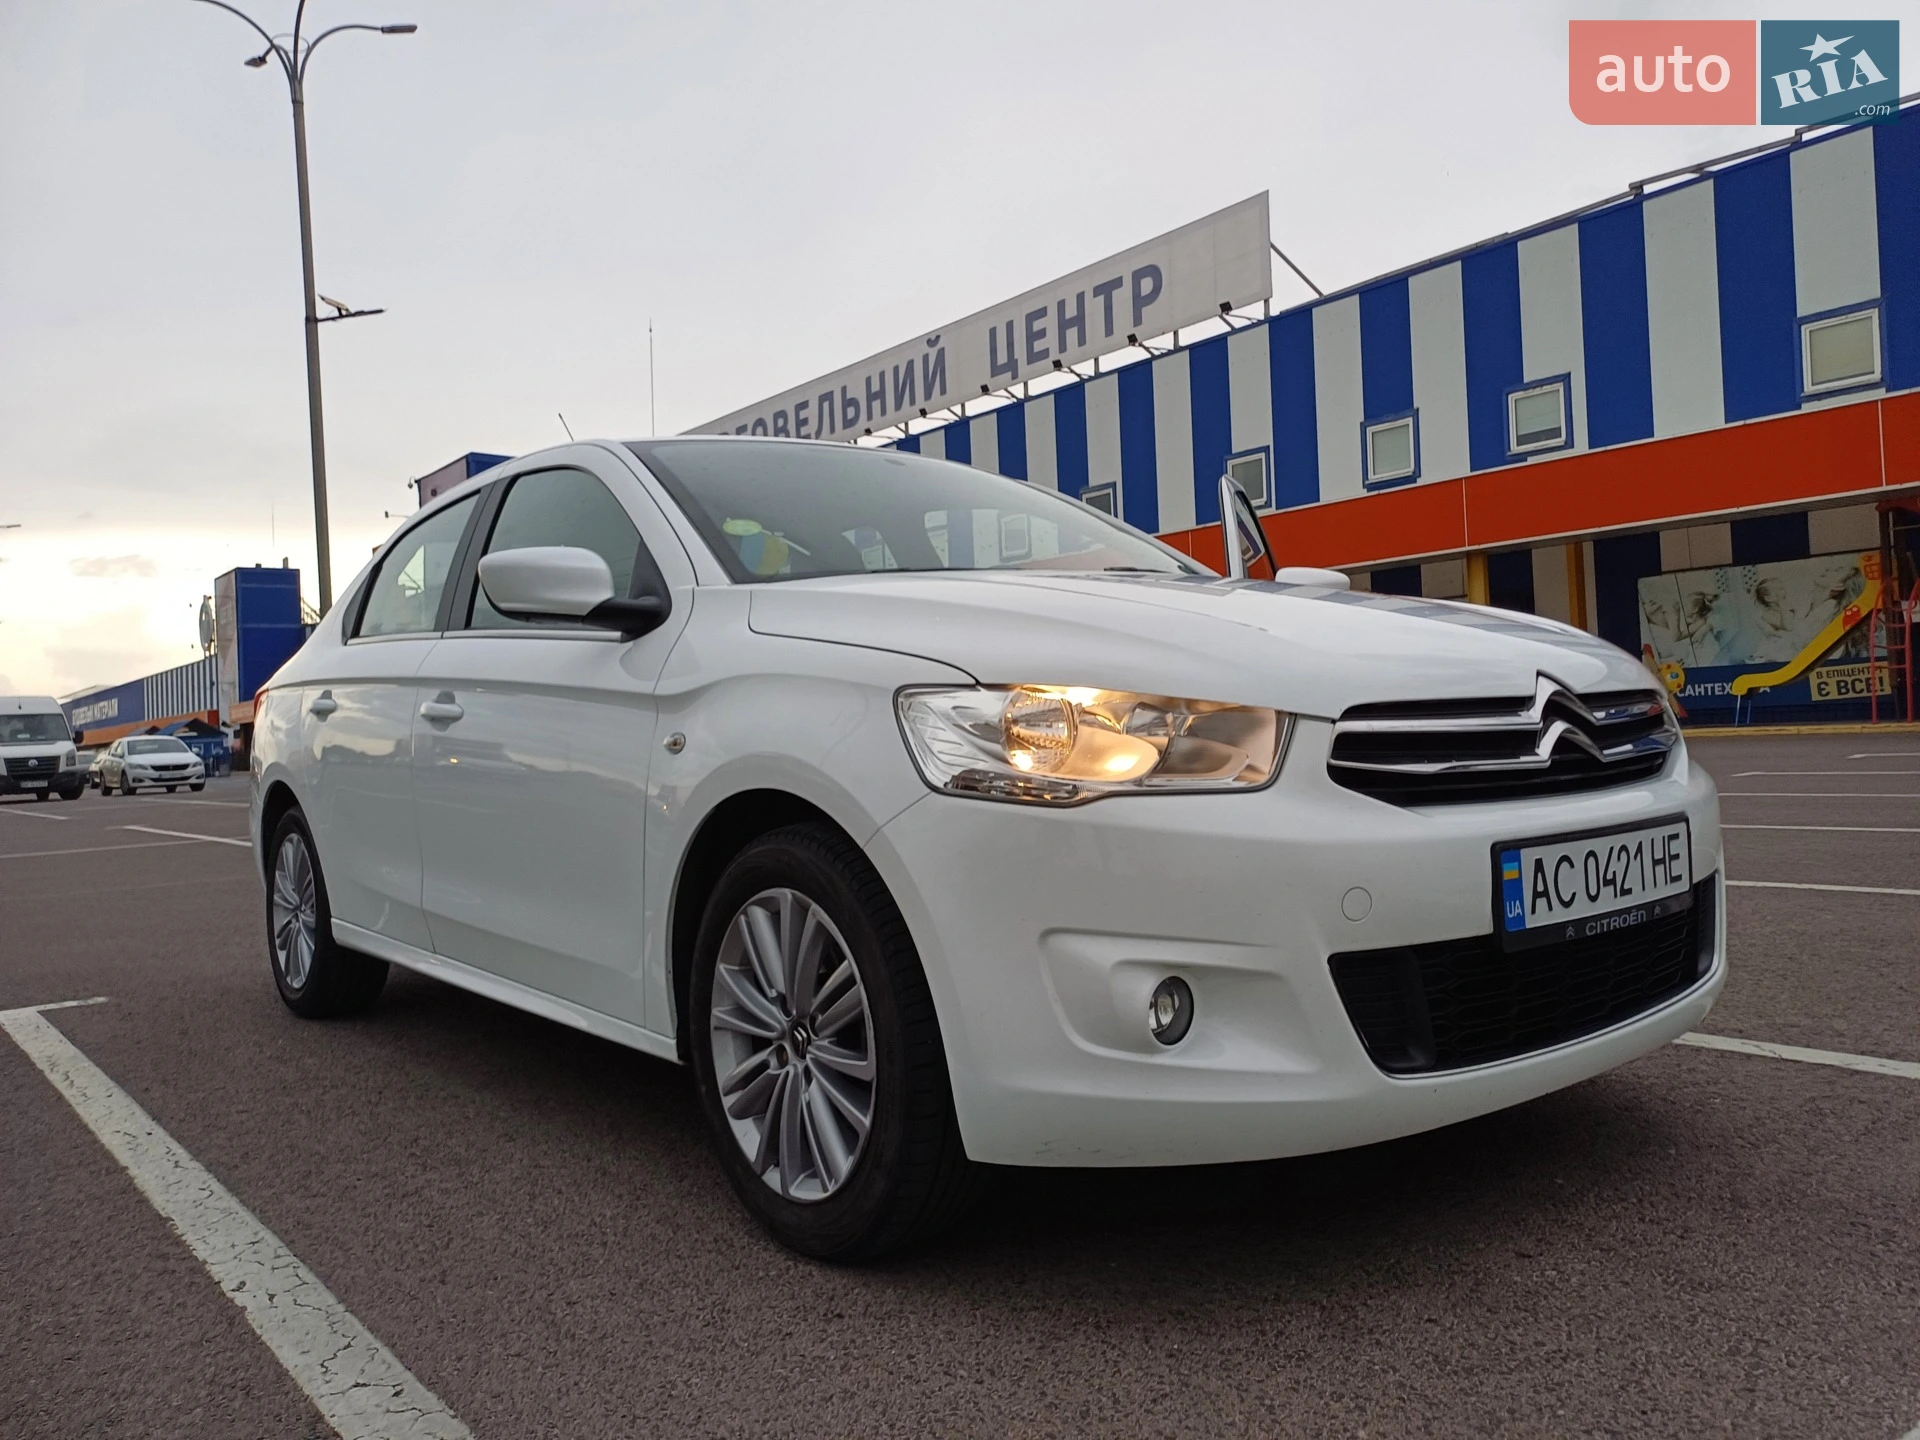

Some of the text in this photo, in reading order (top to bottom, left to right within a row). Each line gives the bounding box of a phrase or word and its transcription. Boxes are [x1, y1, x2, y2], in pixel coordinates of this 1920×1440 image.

[718, 263, 1164, 440] ОВЕЛЬНИЙ ЦЕНТР
[1816, 666, 1883, 680] В ЕПІЦЕНТІ
[1816, 676, 1885, 697] Є ВСЕ!
[1530, 832, 1683, 915] AC 0421 HE
[1506, 899, 1524, 919] UA
